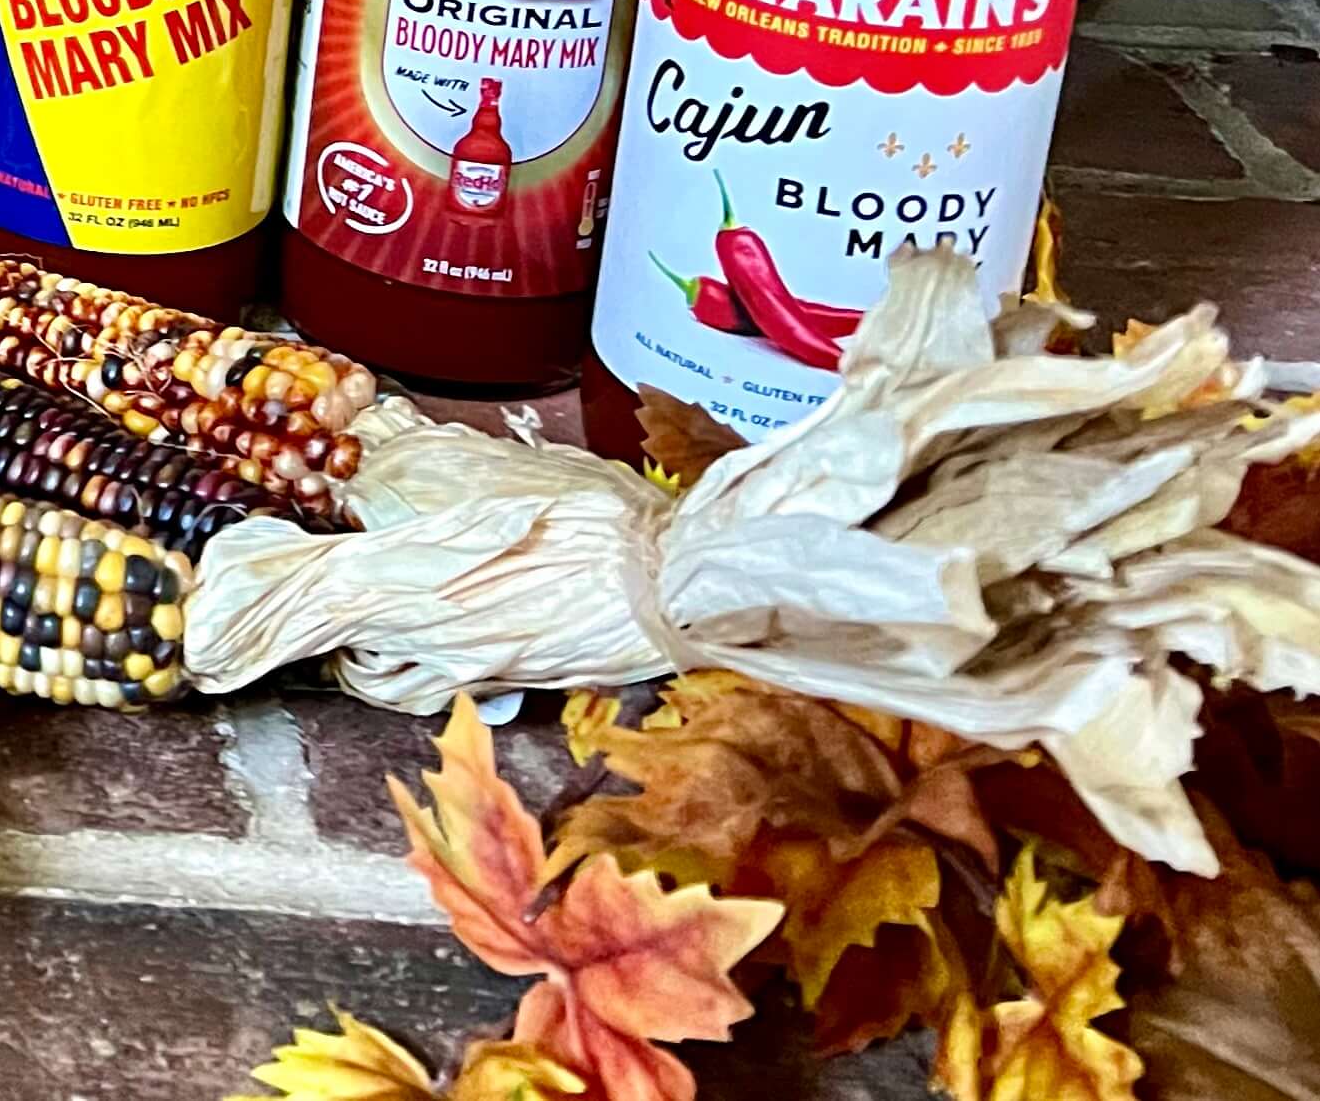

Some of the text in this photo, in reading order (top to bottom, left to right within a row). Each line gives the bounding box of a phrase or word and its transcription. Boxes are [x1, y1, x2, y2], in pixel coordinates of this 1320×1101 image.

[395, 16, 597, 69] BLOODY MARY MIX
[725, 1, 810, 39] ORLEANS
[817, 25, 927, 54] TRADITION
[952, 35, 1005, 54] SINCE
[20, 22, 155, 100] MARY
[396, 66, 469, 91] MADE WITH
[646, 58, 832, 162] Cajun
[68, 212, 124, 227] 32 FL OZ
[70, 193, 123, 210] GLUTEN
[127, 198, 162, 211] FREE
[180, 196, 199, 208] NO
[775, 177, 997, 223] BLOODY
[635, 332, 803, 403] ALL NATURAL GLUTEN
[710, 401, 728, 415] 32
[730, 408, 748, 422] FL
[751, 415, 772, 428] OZ
